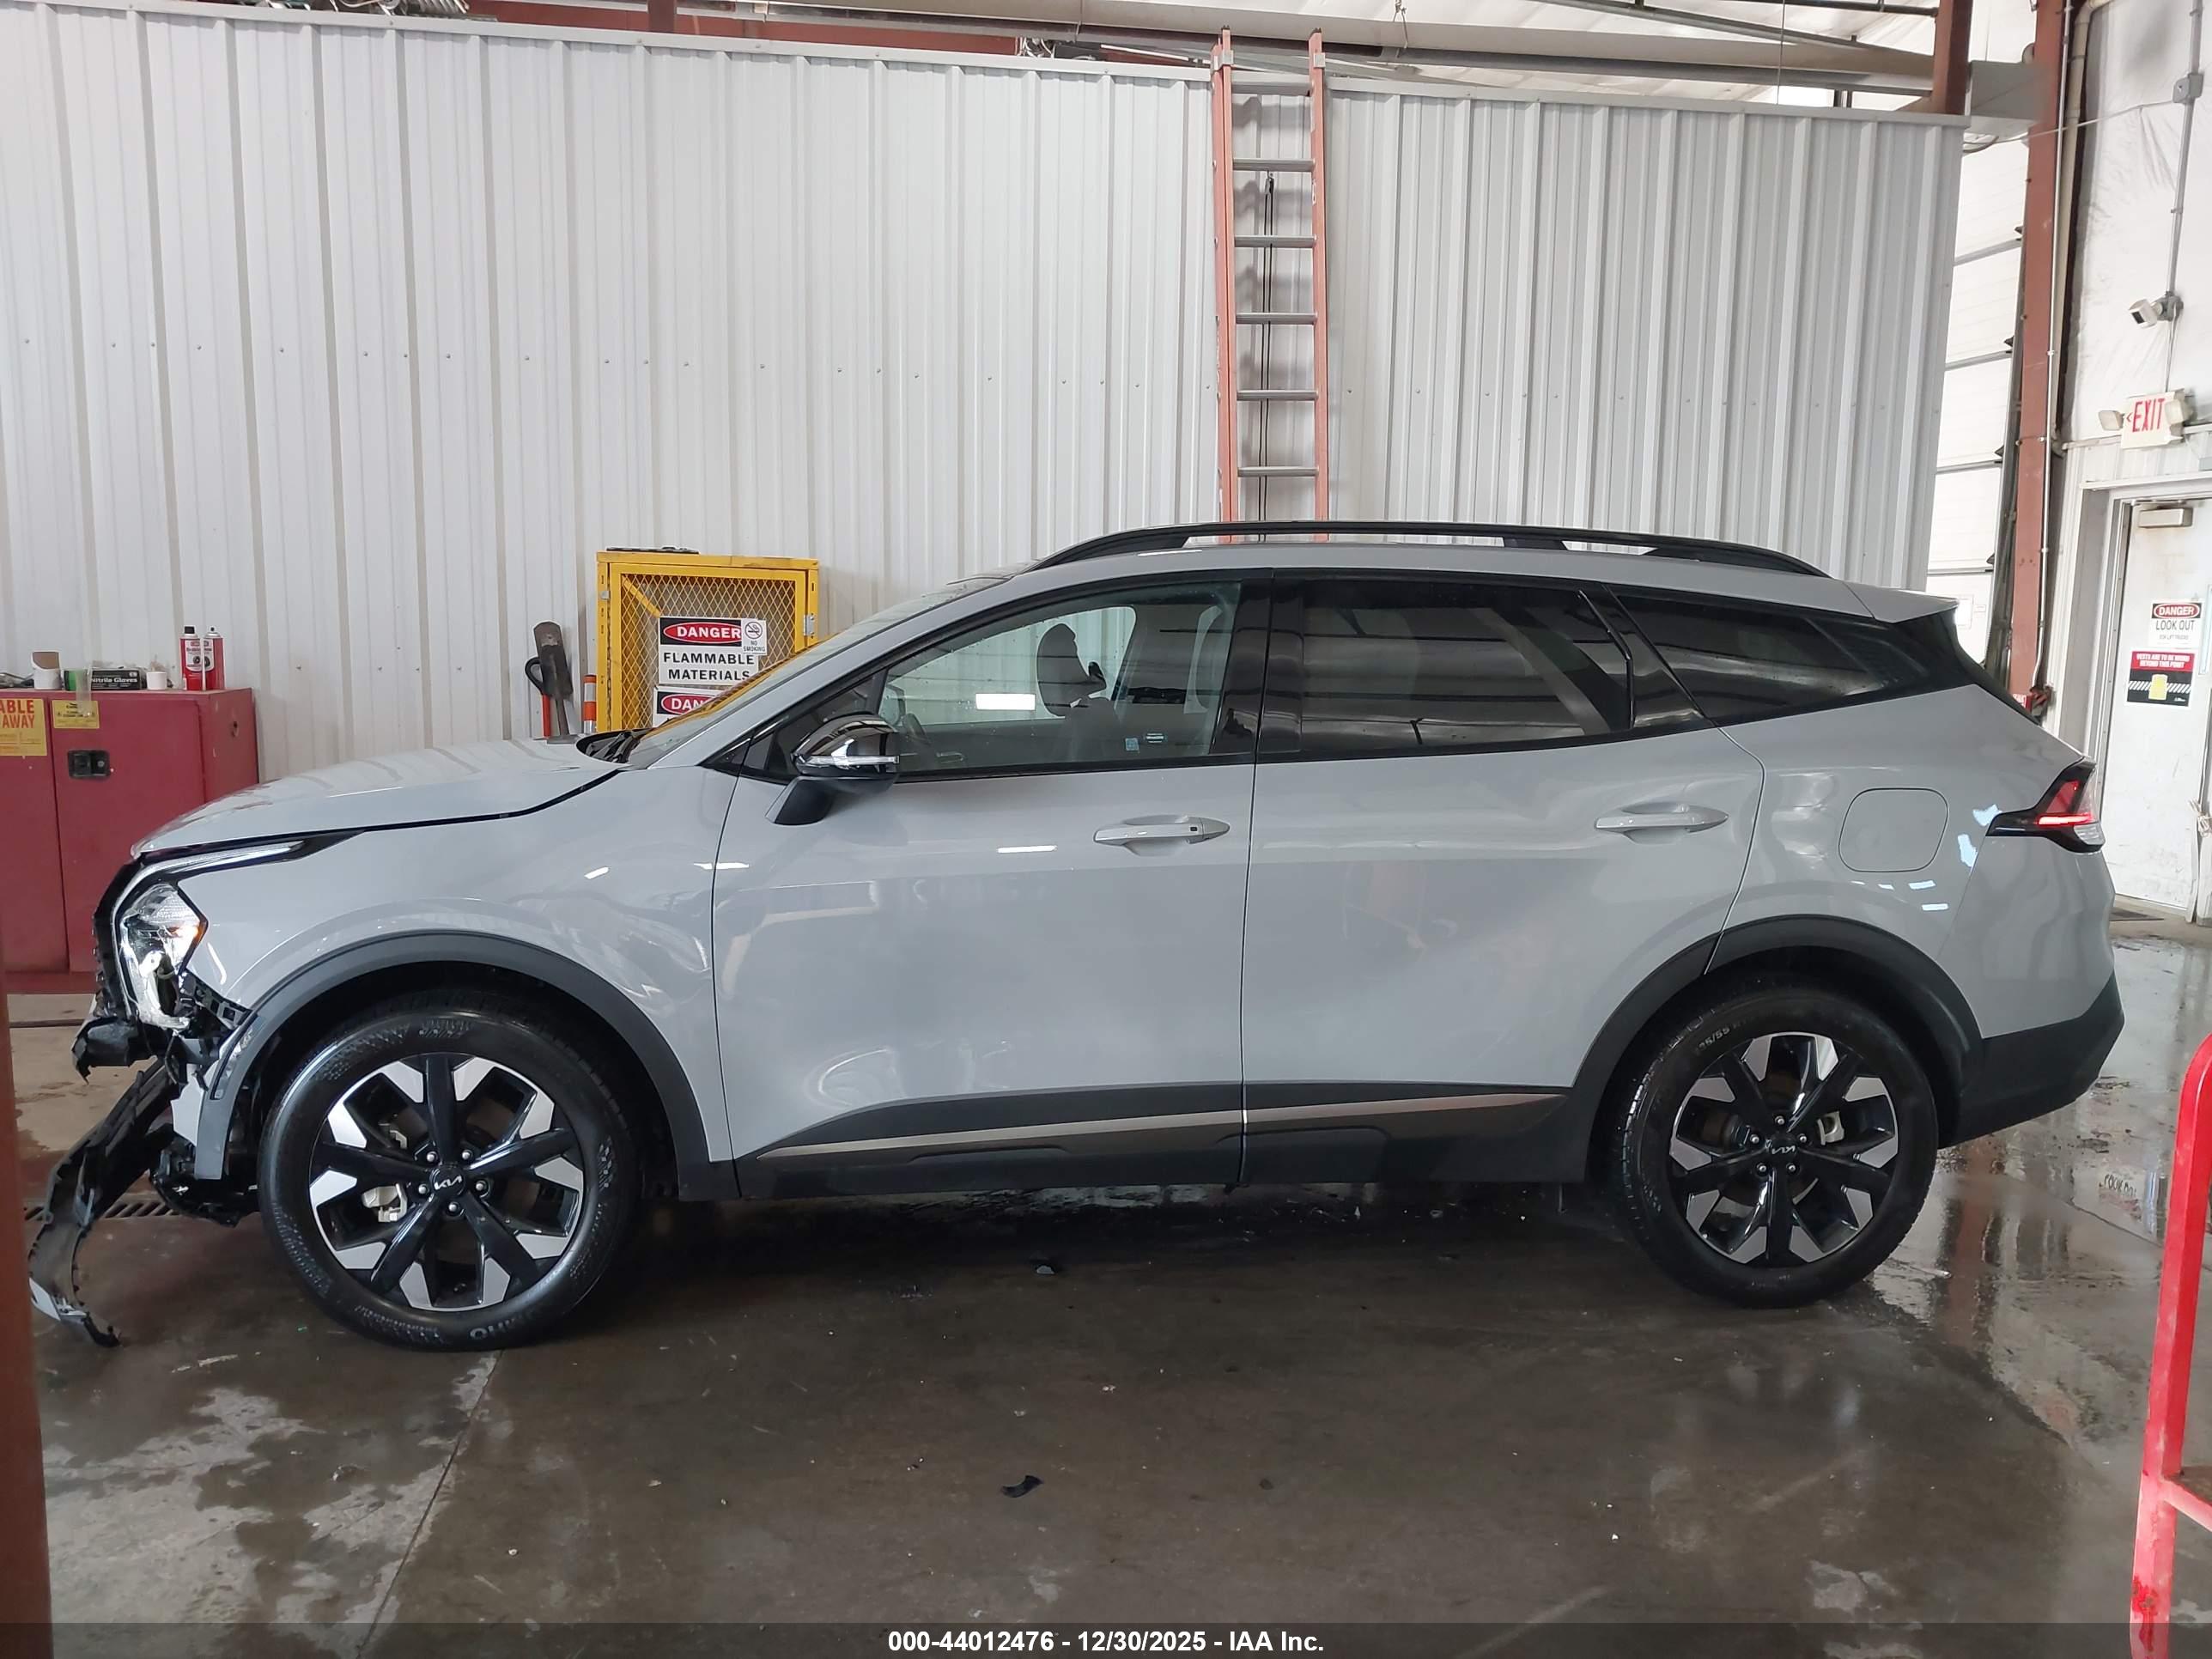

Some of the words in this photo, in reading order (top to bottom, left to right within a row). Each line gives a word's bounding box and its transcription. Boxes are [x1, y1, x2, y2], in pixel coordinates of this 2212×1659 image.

[2132, 398, 2166, 433] EXIT
[2158, 606, 2195, 616] DANGER
[2155, 620, 2177, 630] LOOK
[2179, 619, 2196, 630] OUT
[677, 626, 742, 639] DANGER
[663, 652, 755, 665] FLAMMABLE
[668, 669, 750, 681] MATERIALS
[671, 698, 704, 710] DAN
[3, 714, 35, 728] AWAY
